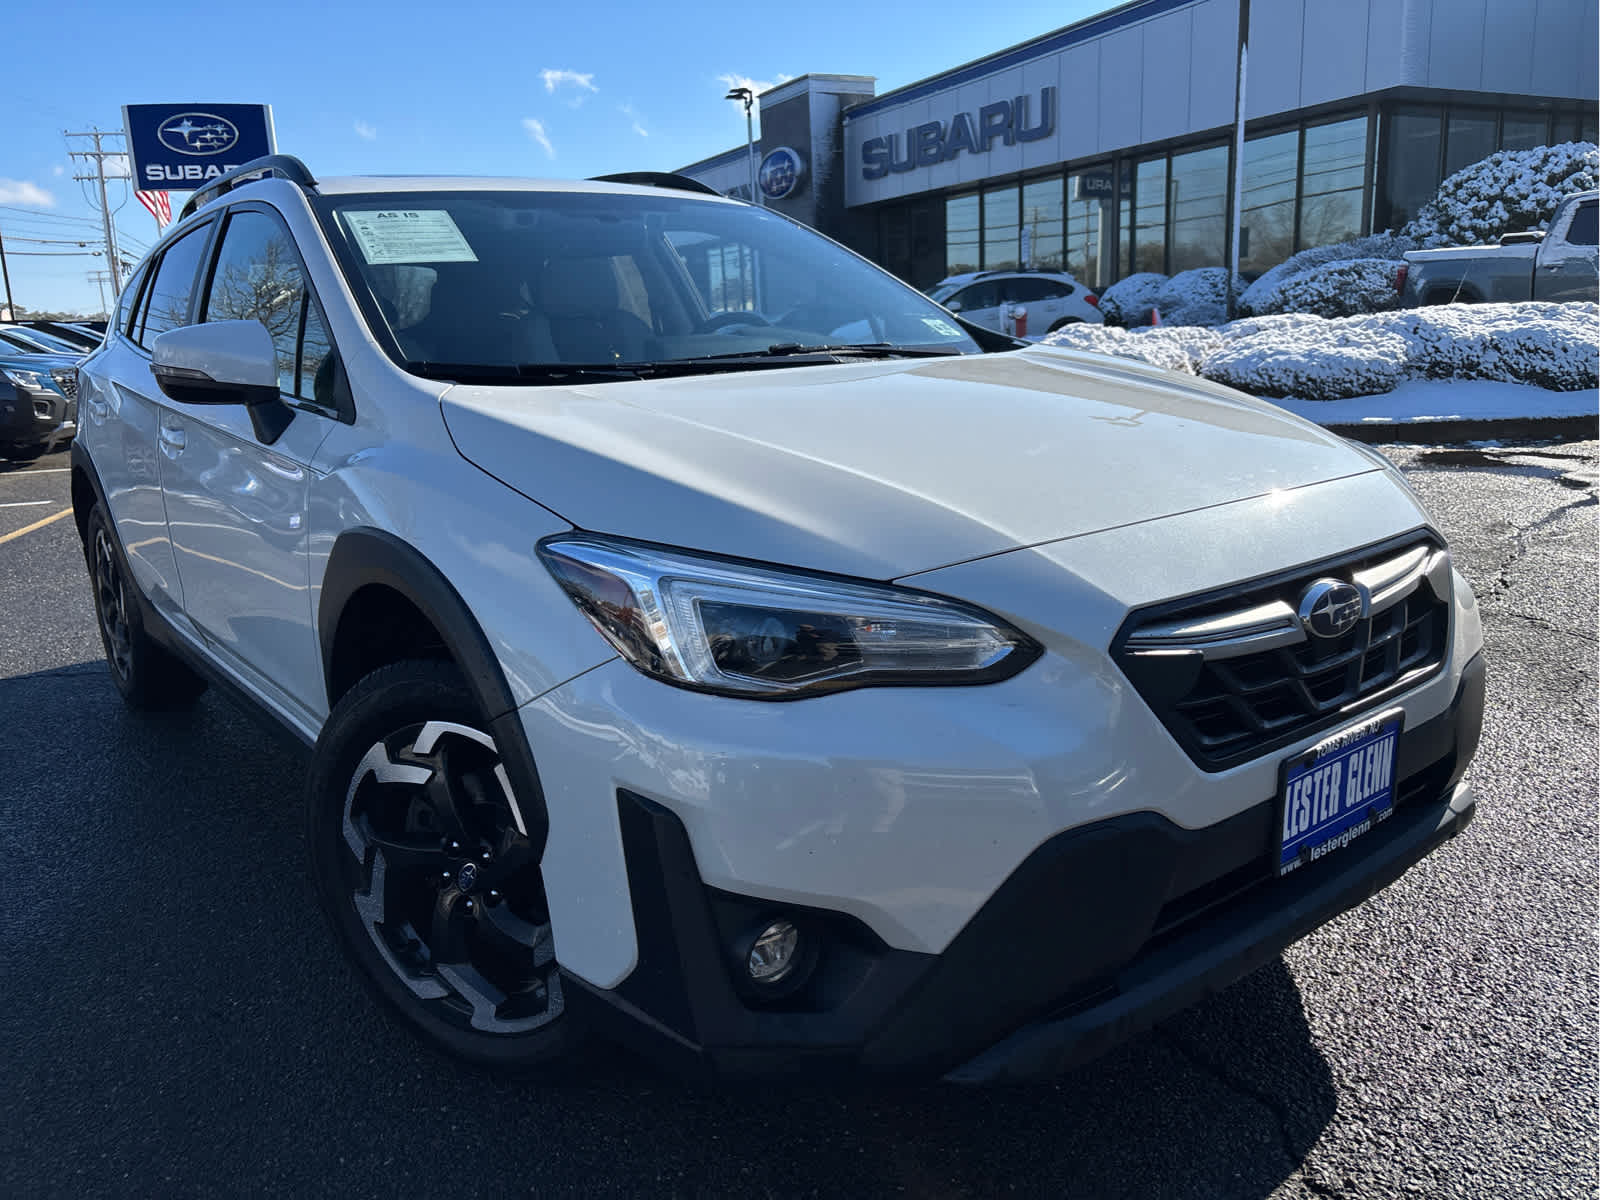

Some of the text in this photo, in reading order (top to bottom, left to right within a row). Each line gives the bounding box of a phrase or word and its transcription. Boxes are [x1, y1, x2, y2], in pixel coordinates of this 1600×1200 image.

[862, 86, 1057, 181] SUBARU
[1282, 736, 1394, 841] LESTER GLENN
[1316, 736, 1340, 760] TOMS
